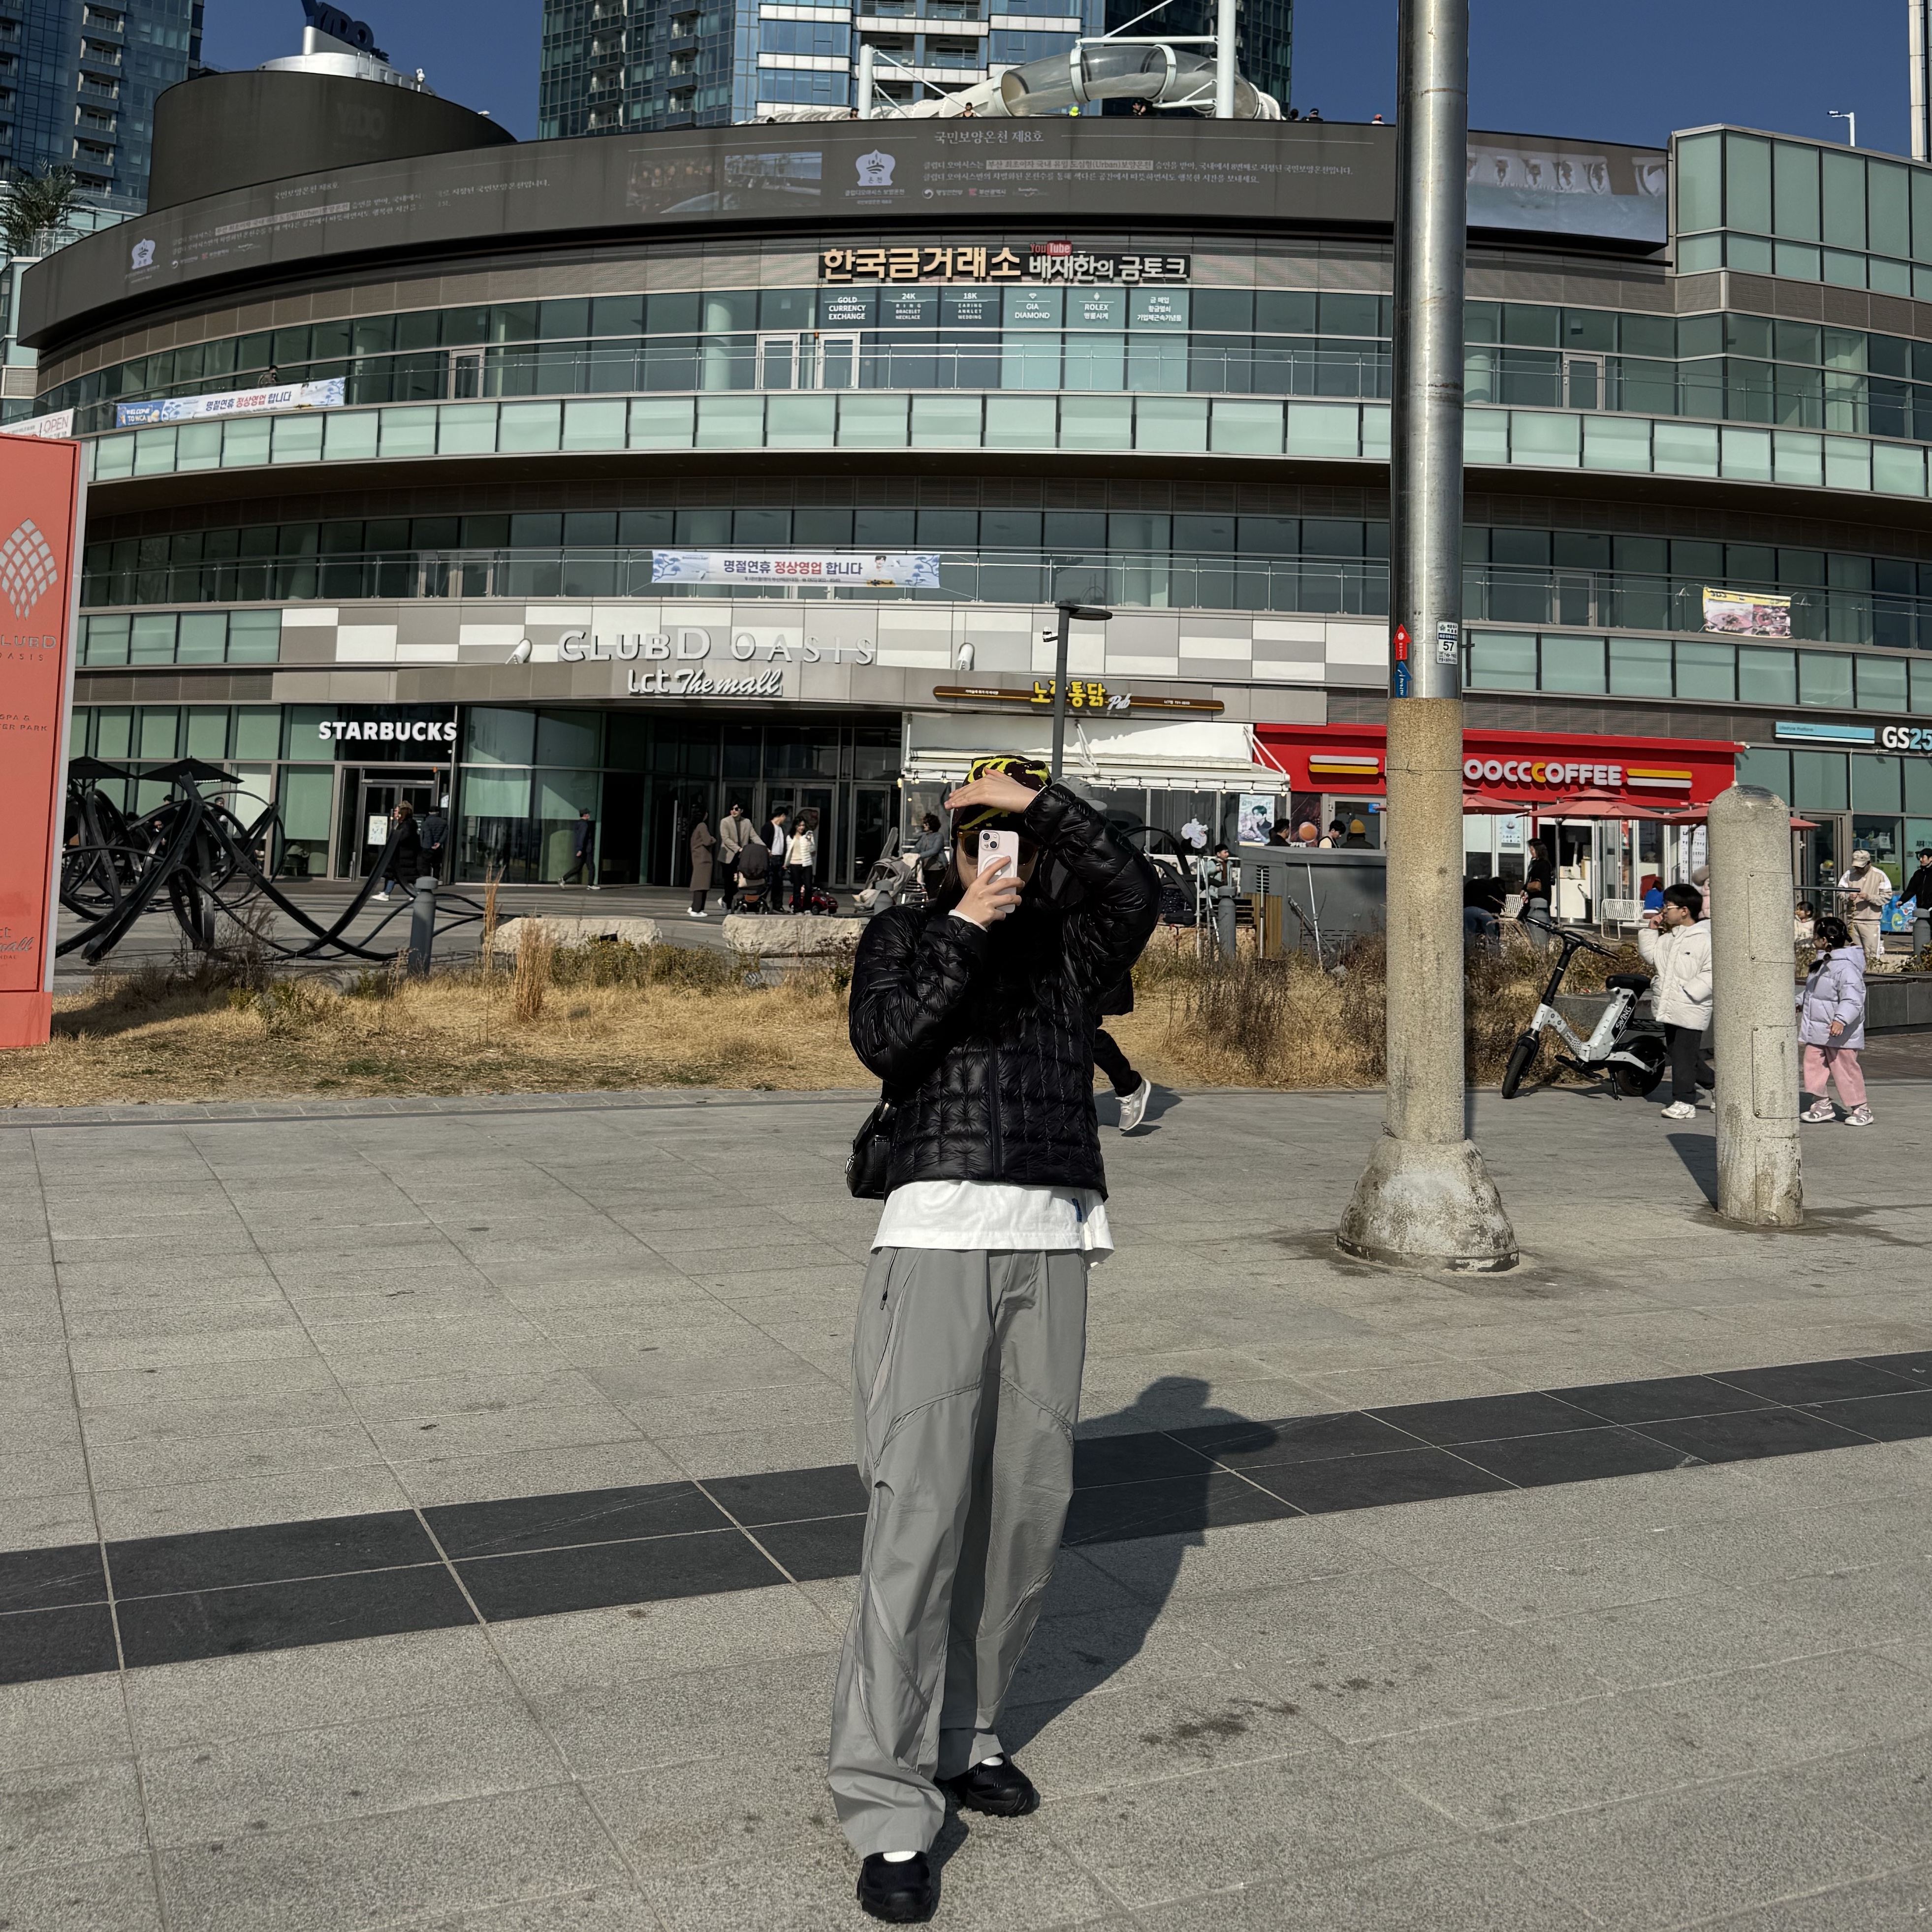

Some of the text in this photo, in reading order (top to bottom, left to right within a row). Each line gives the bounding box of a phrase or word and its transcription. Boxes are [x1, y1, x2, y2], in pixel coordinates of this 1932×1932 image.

[935, 130, 1044, 143] 국민보양온천 제8호
[1030, 243, 1072, 255] YouTube
[824, 248, 1021, 280] 한국금거래소
[1029, 251, 1187, 281] 배재한의 금토크
[206, 399, 234, 412] 명절연휴
[236, 394, 266, 408] 정상영업
[268, 391, 291, 404] 합니다
[44, 415, 69, 433] OPEN
[723, 560, 863, 575] 명절연휴 정상영업 합니다
[559, 628, 874, 665] CLUBD OASIS
[1443, 641, 1455, 651] 57
[674, 668, 714, 694] The
[717, 668, 782, 694] mall
[318, 721, 457, 740] STARBUCKS
[1882, 726, 1932, 750] GS25
[1615, 1005, 1632, 1030] SWING
